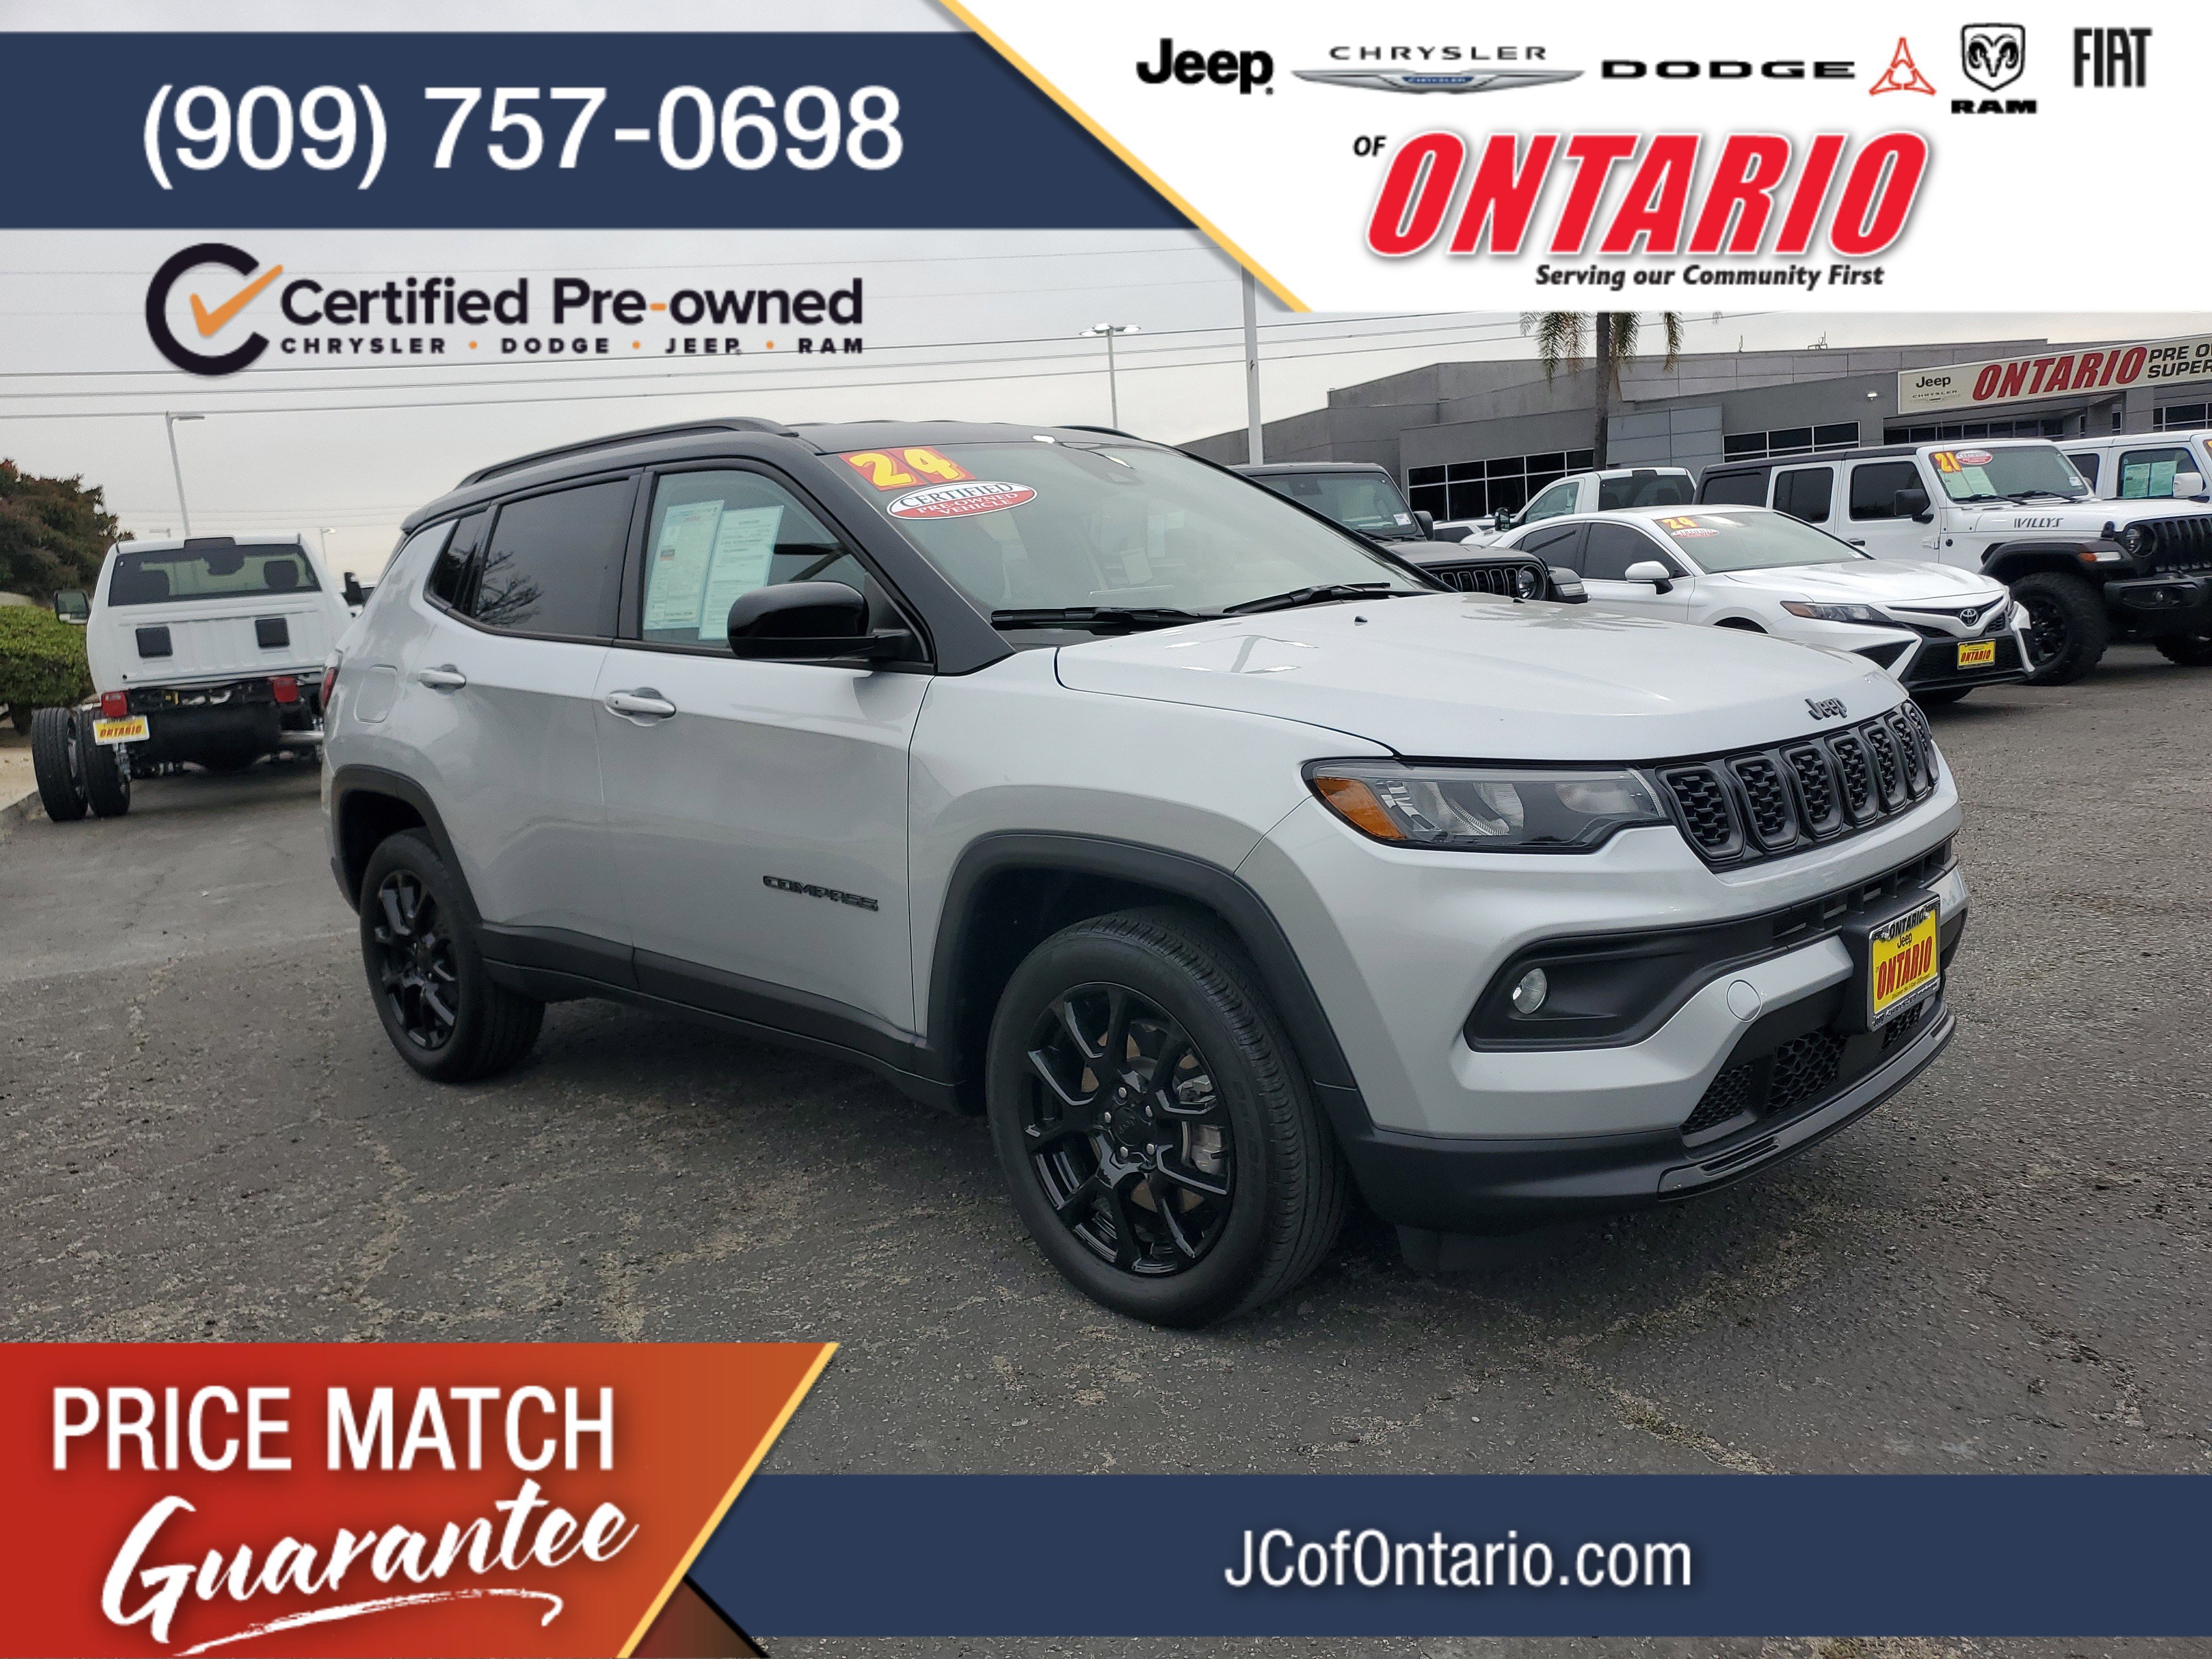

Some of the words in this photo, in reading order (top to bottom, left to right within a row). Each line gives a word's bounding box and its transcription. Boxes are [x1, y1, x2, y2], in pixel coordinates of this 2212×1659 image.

[2148, 346, 2190, 363] PRE
[2195, 343, 2212, 358] O
[1972, 346, 2148, 401] ONTARIO
[2147, 359, 2212, 379] SUPER
[1916, 376, 1951, 388] Jeep
[849, 448, 961, 487] 24
[1934, 452, 1962, 472] 21
[900, 483, 1013, 507] CERTIFIED
[917, 493, 1019, 514] PRE-OWNED
[938, 499, 1013, 515] VEHICLE
[2014, 517, 2064, 528] WILLYS
[1960, 649, 1991, 663] ONTARIO
[1804, 697, 1848, 720] Jeep
[763, 876, 879, 911] COMPASS
[1897, 932, 1912, 949] Jeep
[1877, 935, 1933, 1001] ONTARIO
